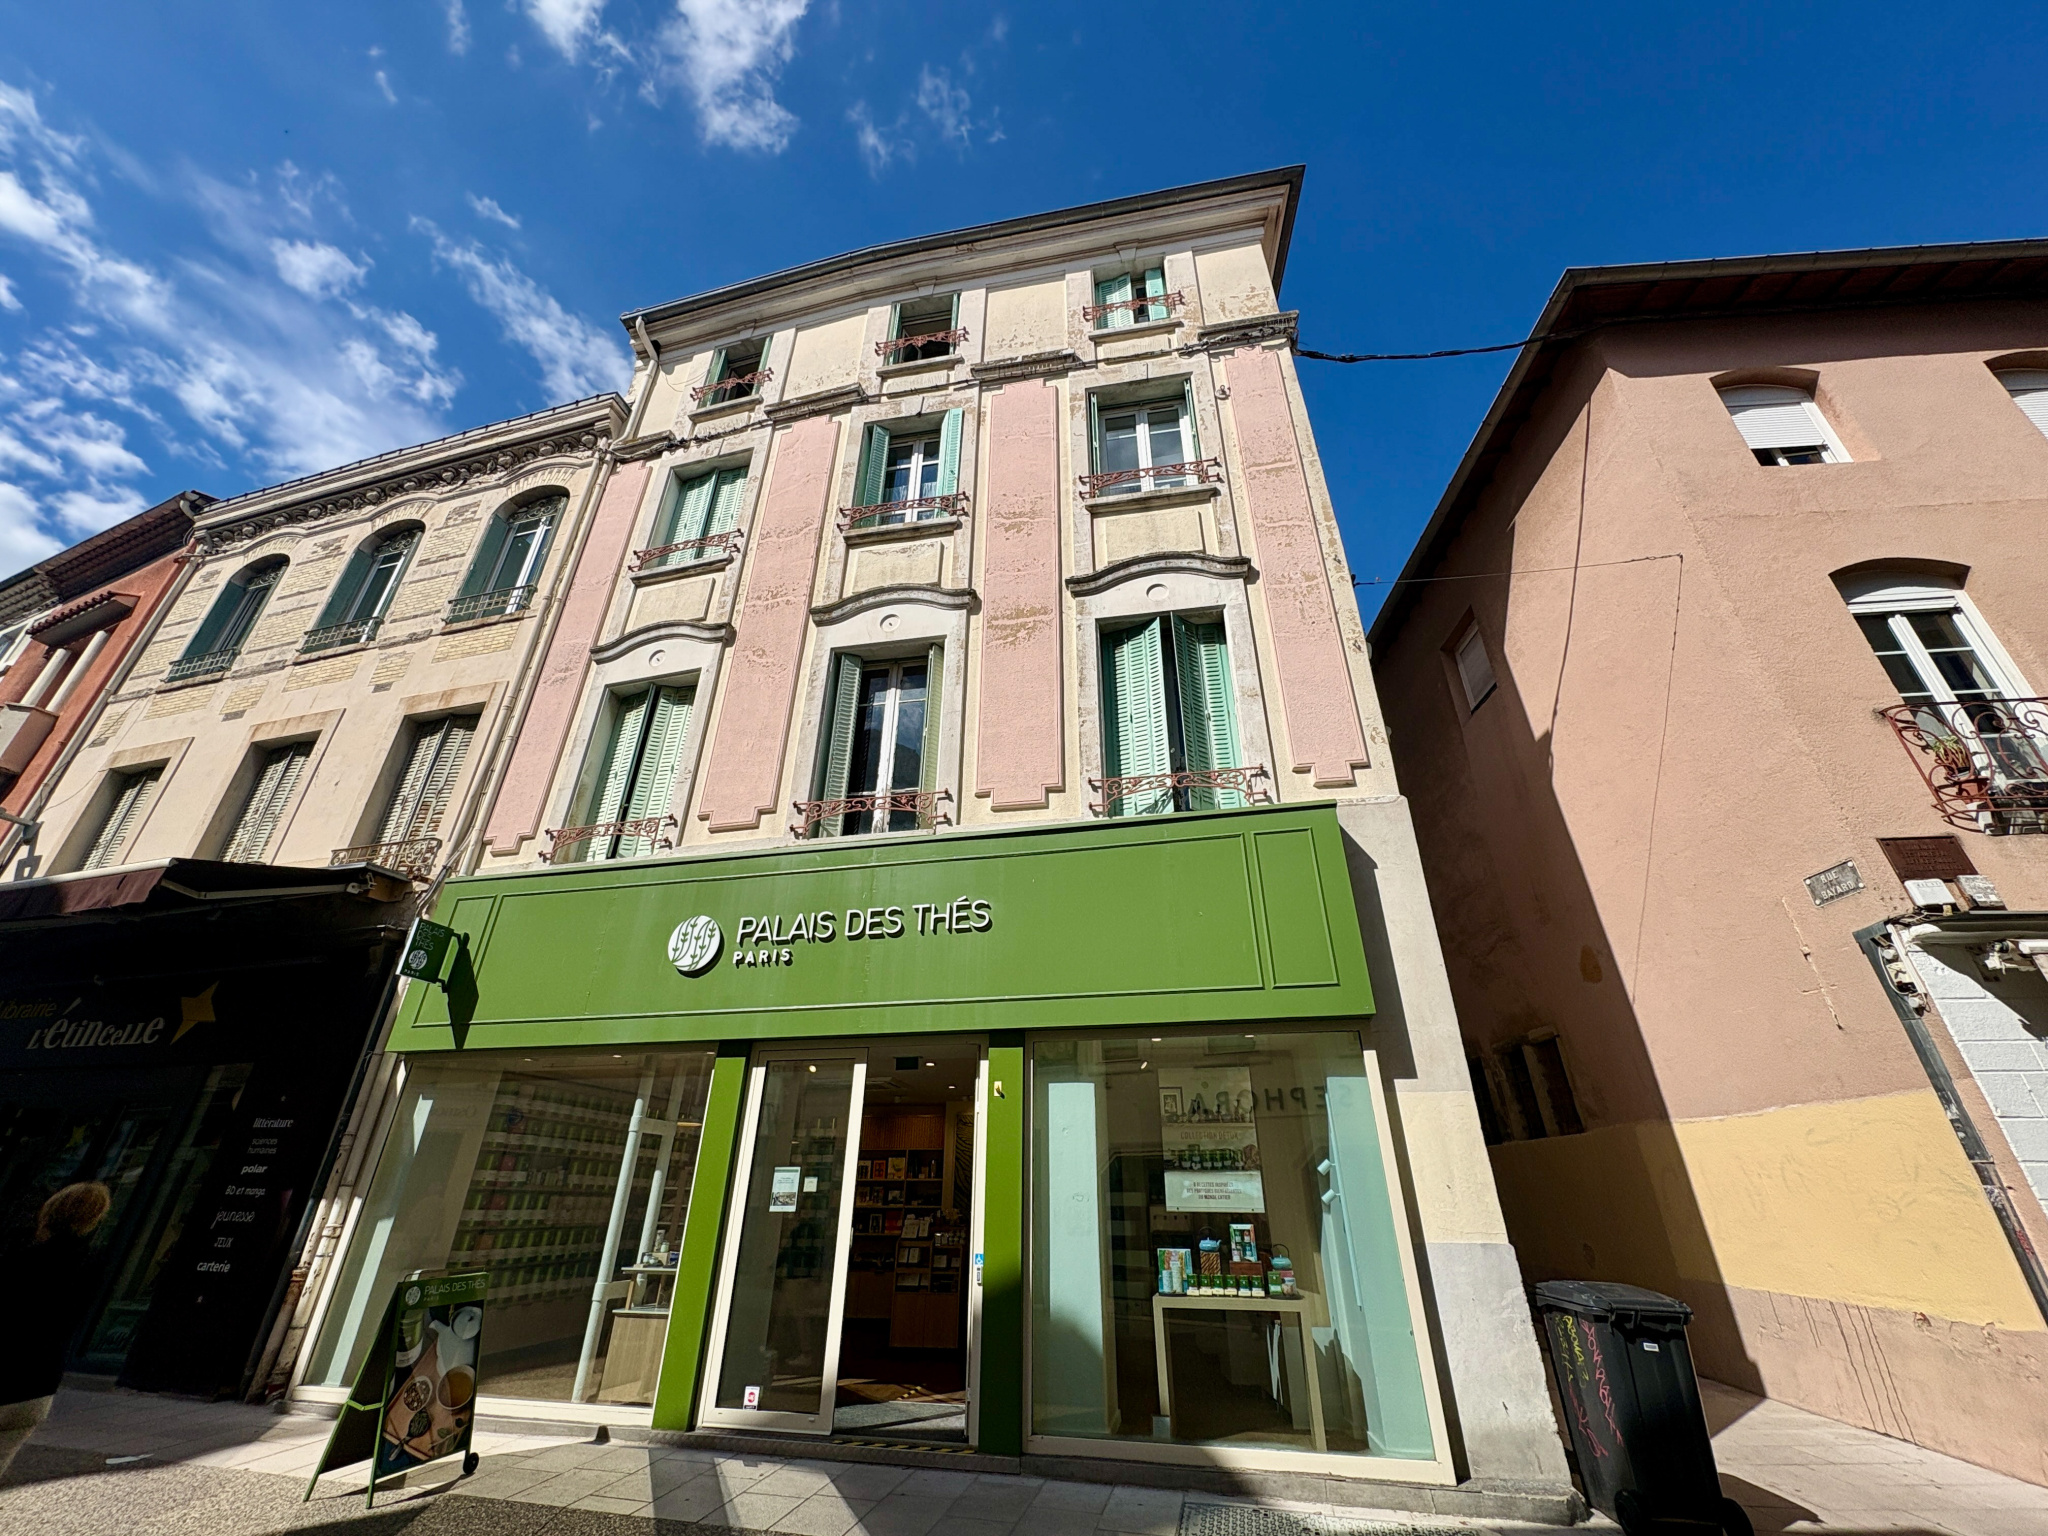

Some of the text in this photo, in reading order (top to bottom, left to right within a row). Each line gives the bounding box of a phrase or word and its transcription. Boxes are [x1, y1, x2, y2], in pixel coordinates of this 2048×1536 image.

[1820, 870, 1839, 884] RUE
[1821, 881, 1855, 900] BAYARD
[736, 896, 990, 943] PALAIS DES THÉS
[732, 948, 792, 965] PARIS
[252, 1117, 293, 1129] littérature
[251, 1137, 278, 1145] sciences
[247, 1145, 277, 1155] humaines
[240, 1164, 268, 1175] polar
[225, 1185, 266, 1198] BD et manga
[210, 1206, 255, 1230] jeunesse
[214, 1236, 233, 1248] JEUX
[197, 1260, 231, 1273] carterie
[424, 1284, 451, 1295] PALAIS
[451, 1281, 467, 1292] DES
